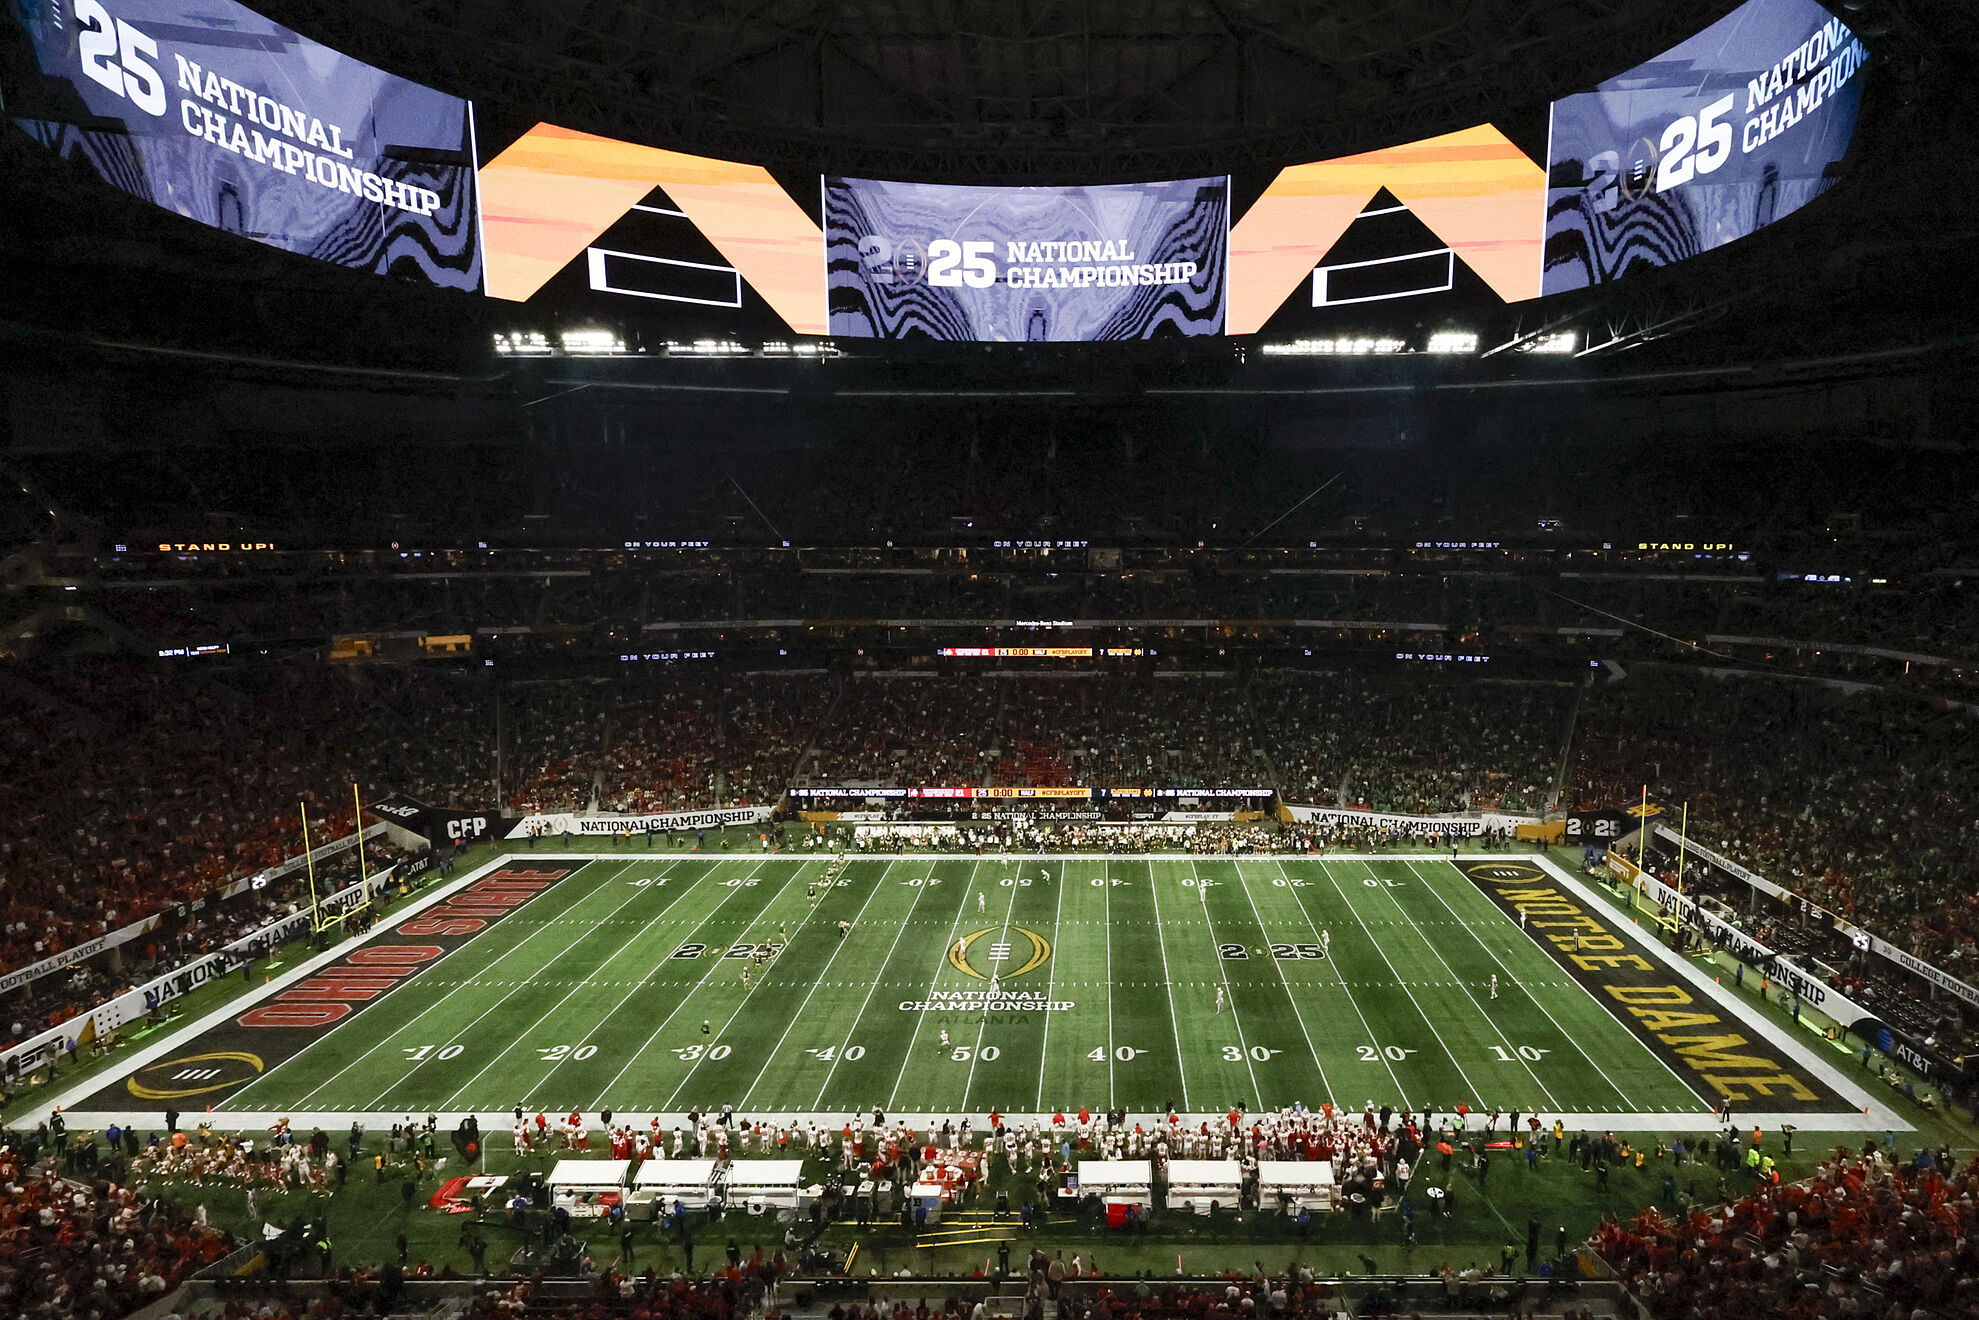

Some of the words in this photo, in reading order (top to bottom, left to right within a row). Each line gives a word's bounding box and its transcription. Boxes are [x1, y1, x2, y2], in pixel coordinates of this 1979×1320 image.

[175, 54, 353, 159] NATIONAL
[181, 99, 441, 217] CHAMPIONSHIP
[1007, 240, 1135, 263] NATIONAL
[1007, 262, 1197, 289] CHAMPIONSHIP
[158, 543, 231, 551] STAND
[241, 543, 275, 551] UP!
[1177, 789, 1215, 797] NATIONAL
[1216, 789, 1273, 797] CHAMPIONSHIP
[447, 817, 486, 839] CFP
[581, 819, 650, 832] NATIONAL
[651, 811, 754, 830] CHAMPIONSHIP
[1311, 812, 1376, 829] NATIONAL
[251, 873, 267, 889] 25
[396, 869, 571, 935] STATE
[1496, 888, 1655, 971] NOTRE
[1853, 931, 1870, 951] 25
[57, 938, 105, 966] PLAYOFF
[1900, 954, 1940, 982] COLLEGE
[236, 945, 445, 1027] OHIO
[931, 991, 1047, 1000] NATIONAL
[898, 1001, 1075, 1011] CHAMPIONSHIP
[937, 1015, 1030, 1025] ATLANTA
[1604, 984, 1820, 1101] DAME
[405, 1045, 464, 1061] 10
[541, 1045, 598, 1061] 20
[679, 1045, 731, 1061] 30
[815, 1046, 865, 1062] 40
[951, 1046, 1000, 1062] 50
[1087, 1046, 1136, 1062] 40
[1222, 1046, 1270, 1062] 30
[1356, 1046, 1406, 1062] 20
[1488, 1046, 1542, 1062] 10
[1897, 1044, 1932, 1075] AT&T
